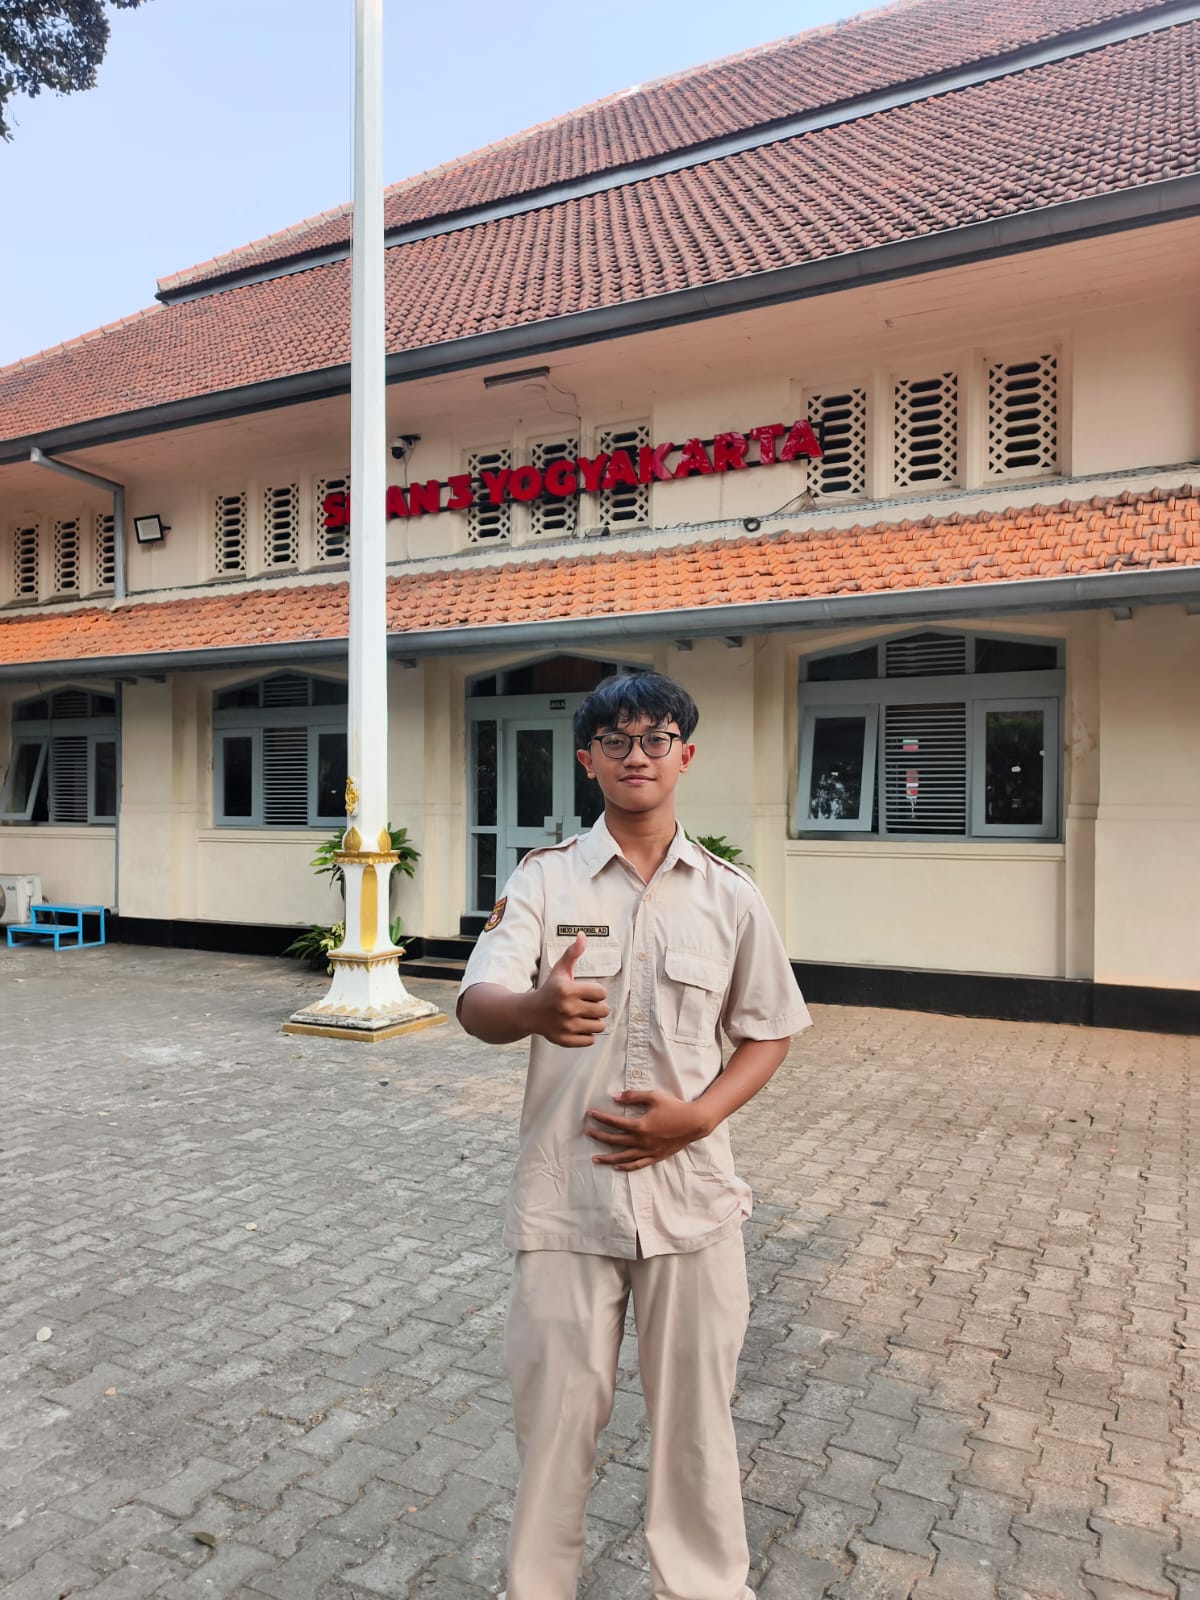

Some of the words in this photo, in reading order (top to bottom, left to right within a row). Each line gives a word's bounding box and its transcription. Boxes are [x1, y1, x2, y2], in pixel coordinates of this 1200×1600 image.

[322, 479, 439, 528] SAN
[446, 474, 473, 509] 3
[481, 418, 823, 505] YOGYAKARTA
